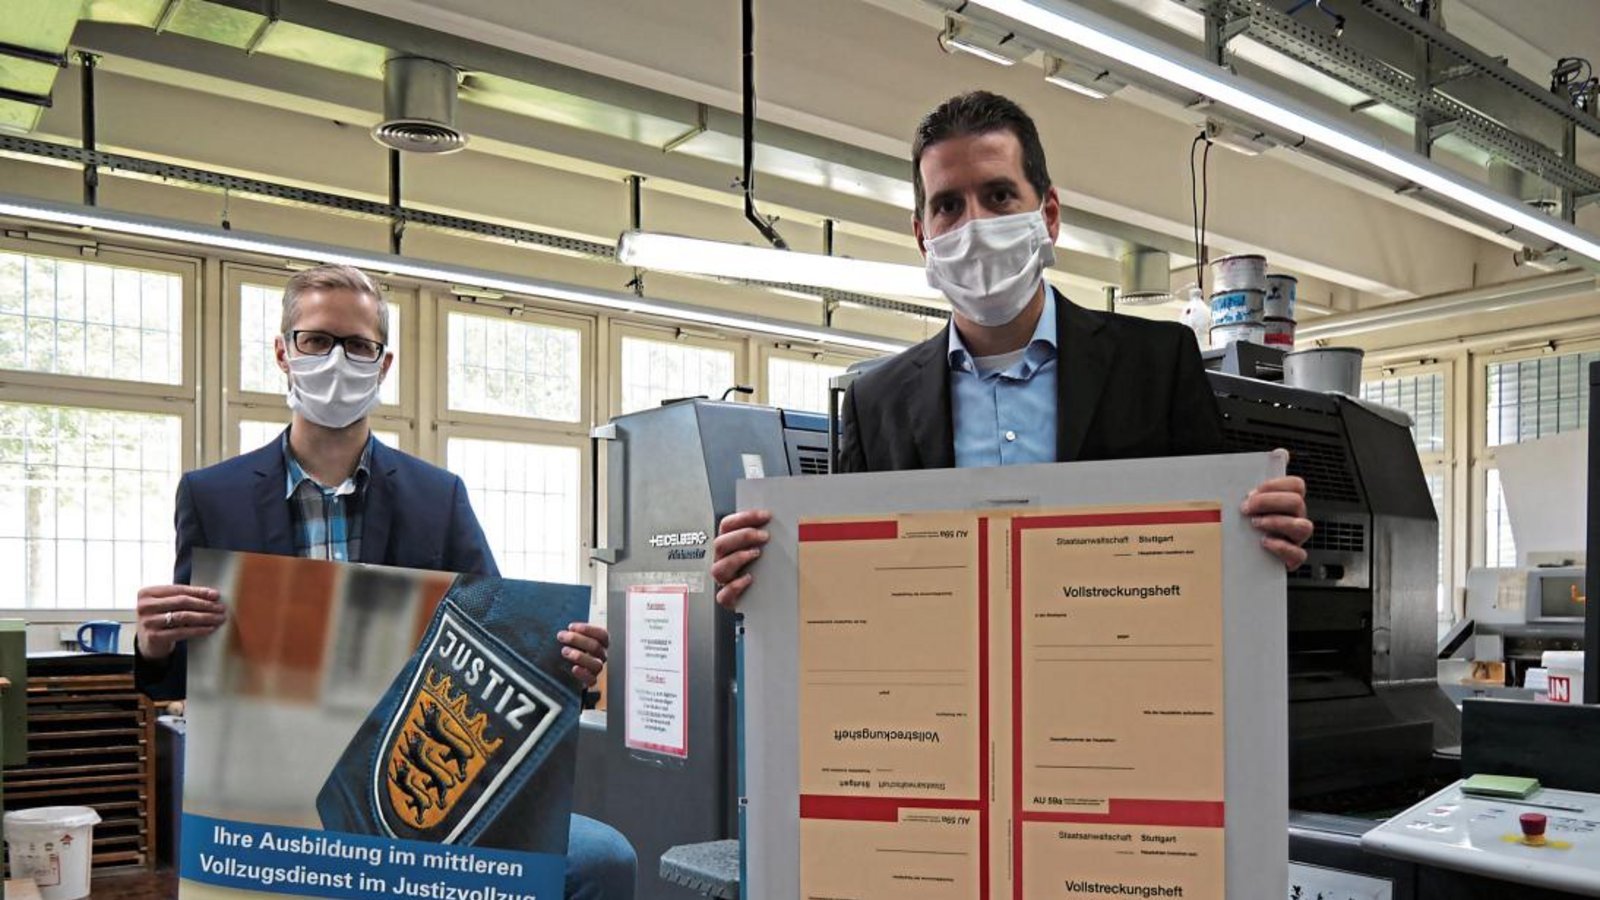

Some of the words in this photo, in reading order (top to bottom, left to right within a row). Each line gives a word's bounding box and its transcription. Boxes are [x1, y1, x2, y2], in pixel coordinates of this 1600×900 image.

[1056, 536, 1129, 546] Staatsanwaltschaft
[1139, 535, 1174, 545] Stuttgart
[1063, 584, 1181, 599] Vollstreckungsheft
[439, 630, 536, 731] JUSTIZ
[834, 728, 940, 742] Vollstreckungsheft
[1058, 831, 1132, 841] Staatsanwaltschaft
[1141, 834, 1177, 844] Stuttgart
[213, 825, 253, 848] Ihre
[259, 832, 382, 866] Ausbildung
[389, 846, 415, 866] im
[423, 852, 523, 877] mittleren
[200, 853, 352, 889] Vollzugsdienst
[360, 872, 386, 892] im
[393, 877, 536, 900] Justizvollz
[1065, 880, 1183, 898] Vollstreckungsheft
